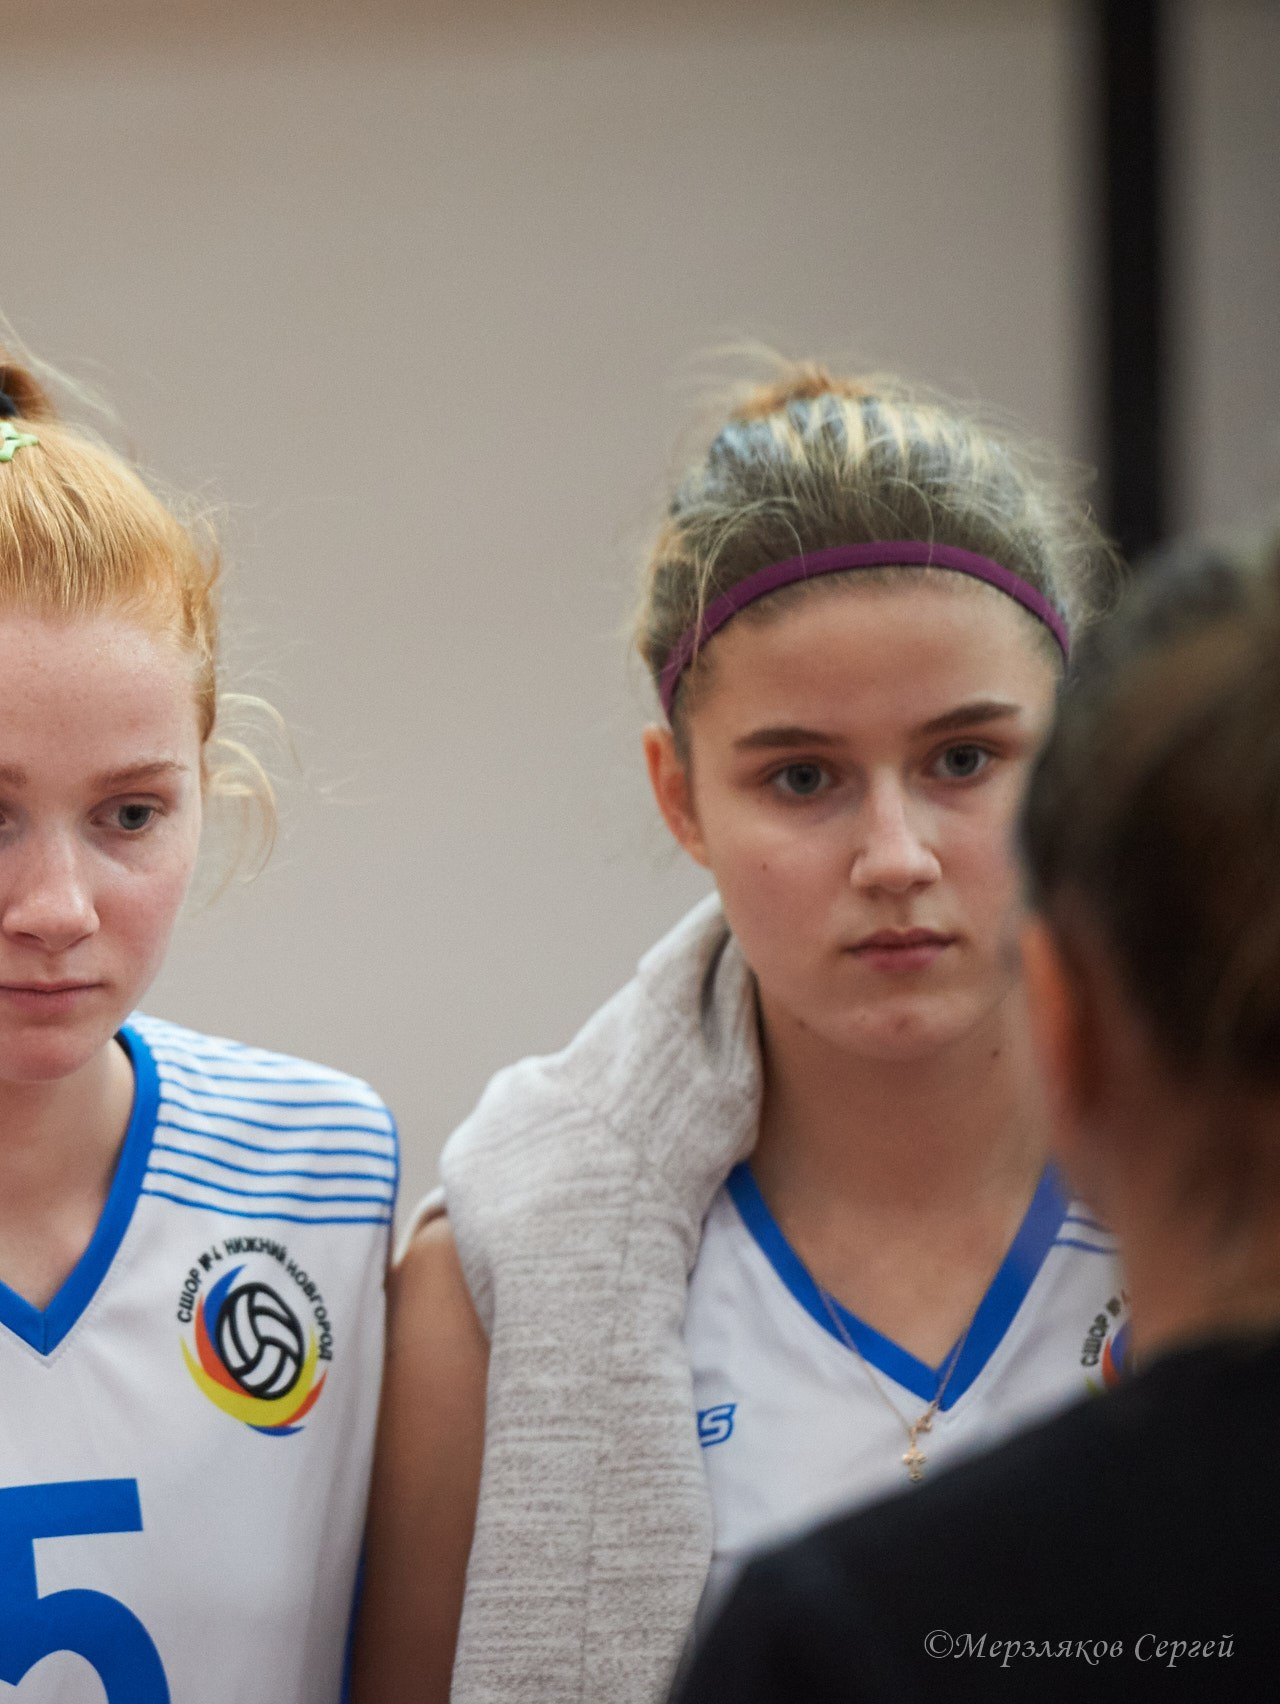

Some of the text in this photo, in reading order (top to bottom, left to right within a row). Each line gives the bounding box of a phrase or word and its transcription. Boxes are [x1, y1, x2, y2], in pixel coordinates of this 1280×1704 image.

[177, 1267, 202, 1324] СШОР
[223, 1237, 288, 1265] НИЖНИЙ
[286, 1258, 333, 1361] НОВГОРОД
[697, 1403, 737, 1448] S
